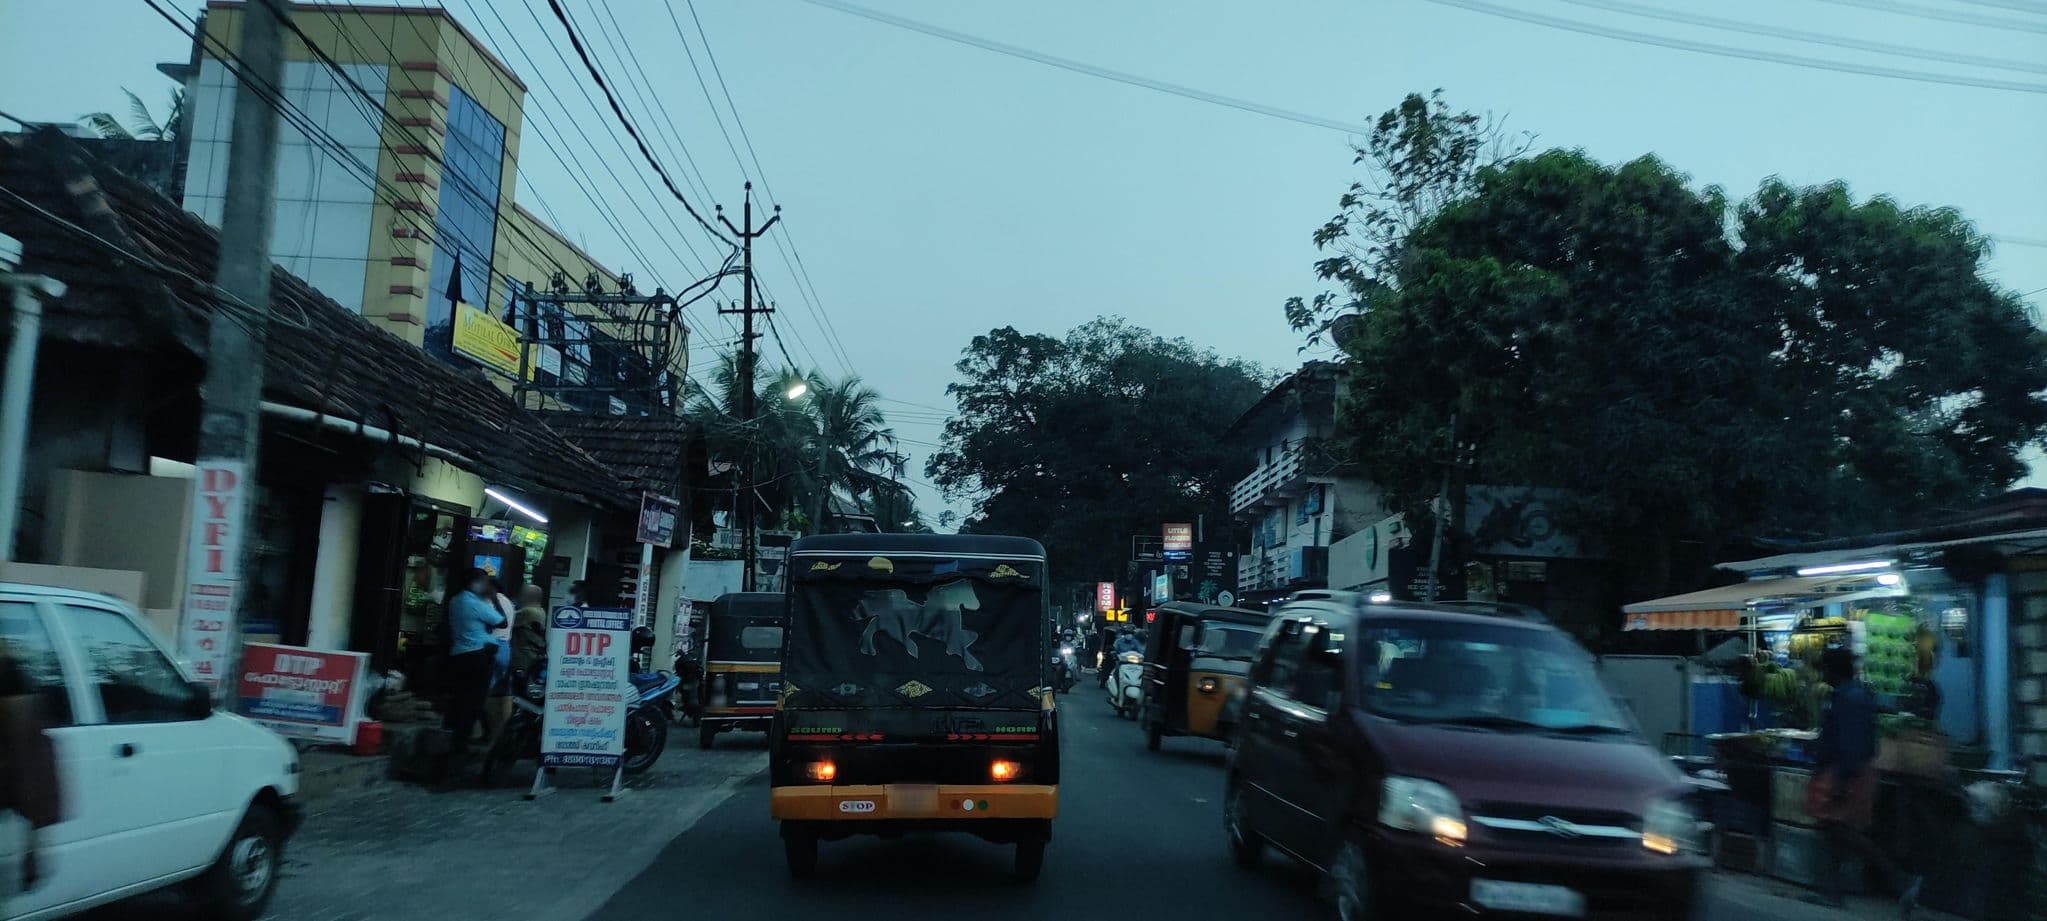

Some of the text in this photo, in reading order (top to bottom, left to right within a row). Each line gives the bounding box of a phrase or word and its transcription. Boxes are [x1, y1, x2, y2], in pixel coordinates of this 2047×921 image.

[202, 468, 237, 573] DYFI
[566, 632, 612, 656] DTP
[273, 653, 325, 675] DTP
[842, 802, 873, 811] STOP
